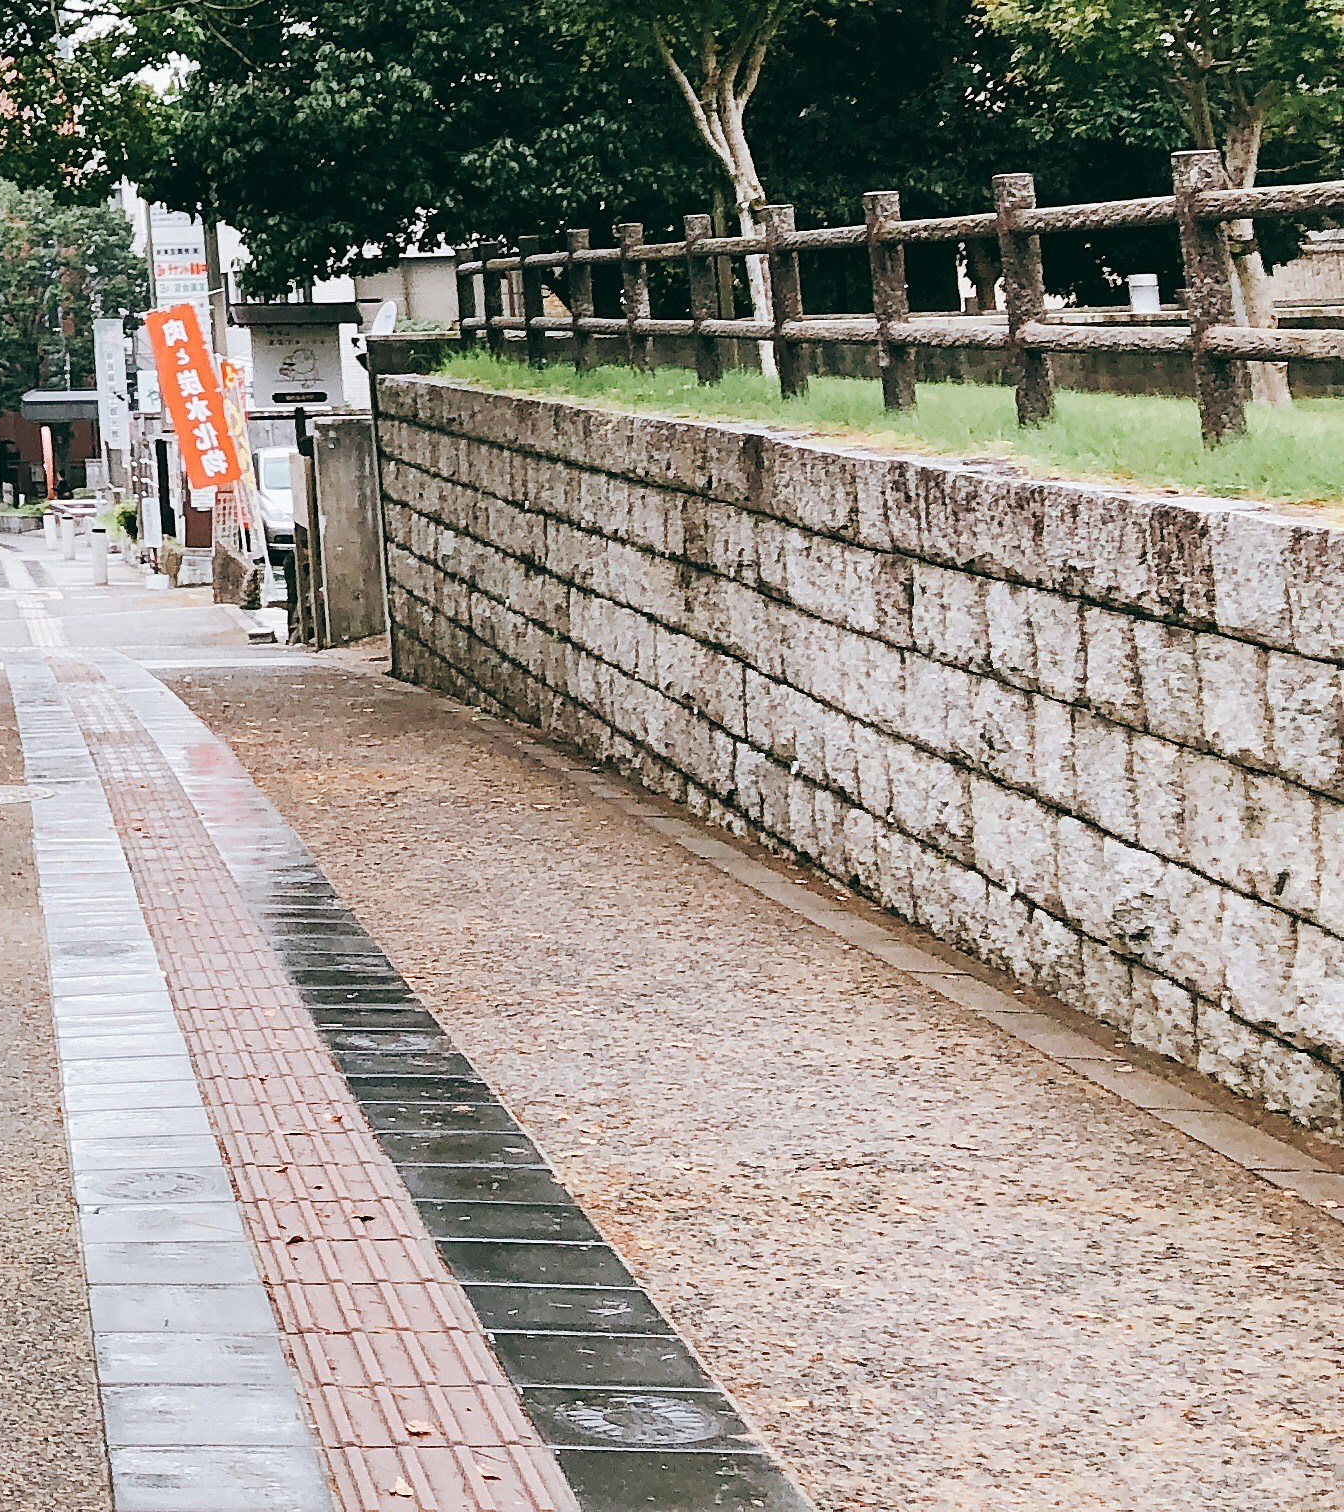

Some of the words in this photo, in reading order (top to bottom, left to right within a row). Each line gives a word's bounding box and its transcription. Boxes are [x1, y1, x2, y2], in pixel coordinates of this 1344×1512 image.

[161, 318, 229, 478] 肉と炭水化物
